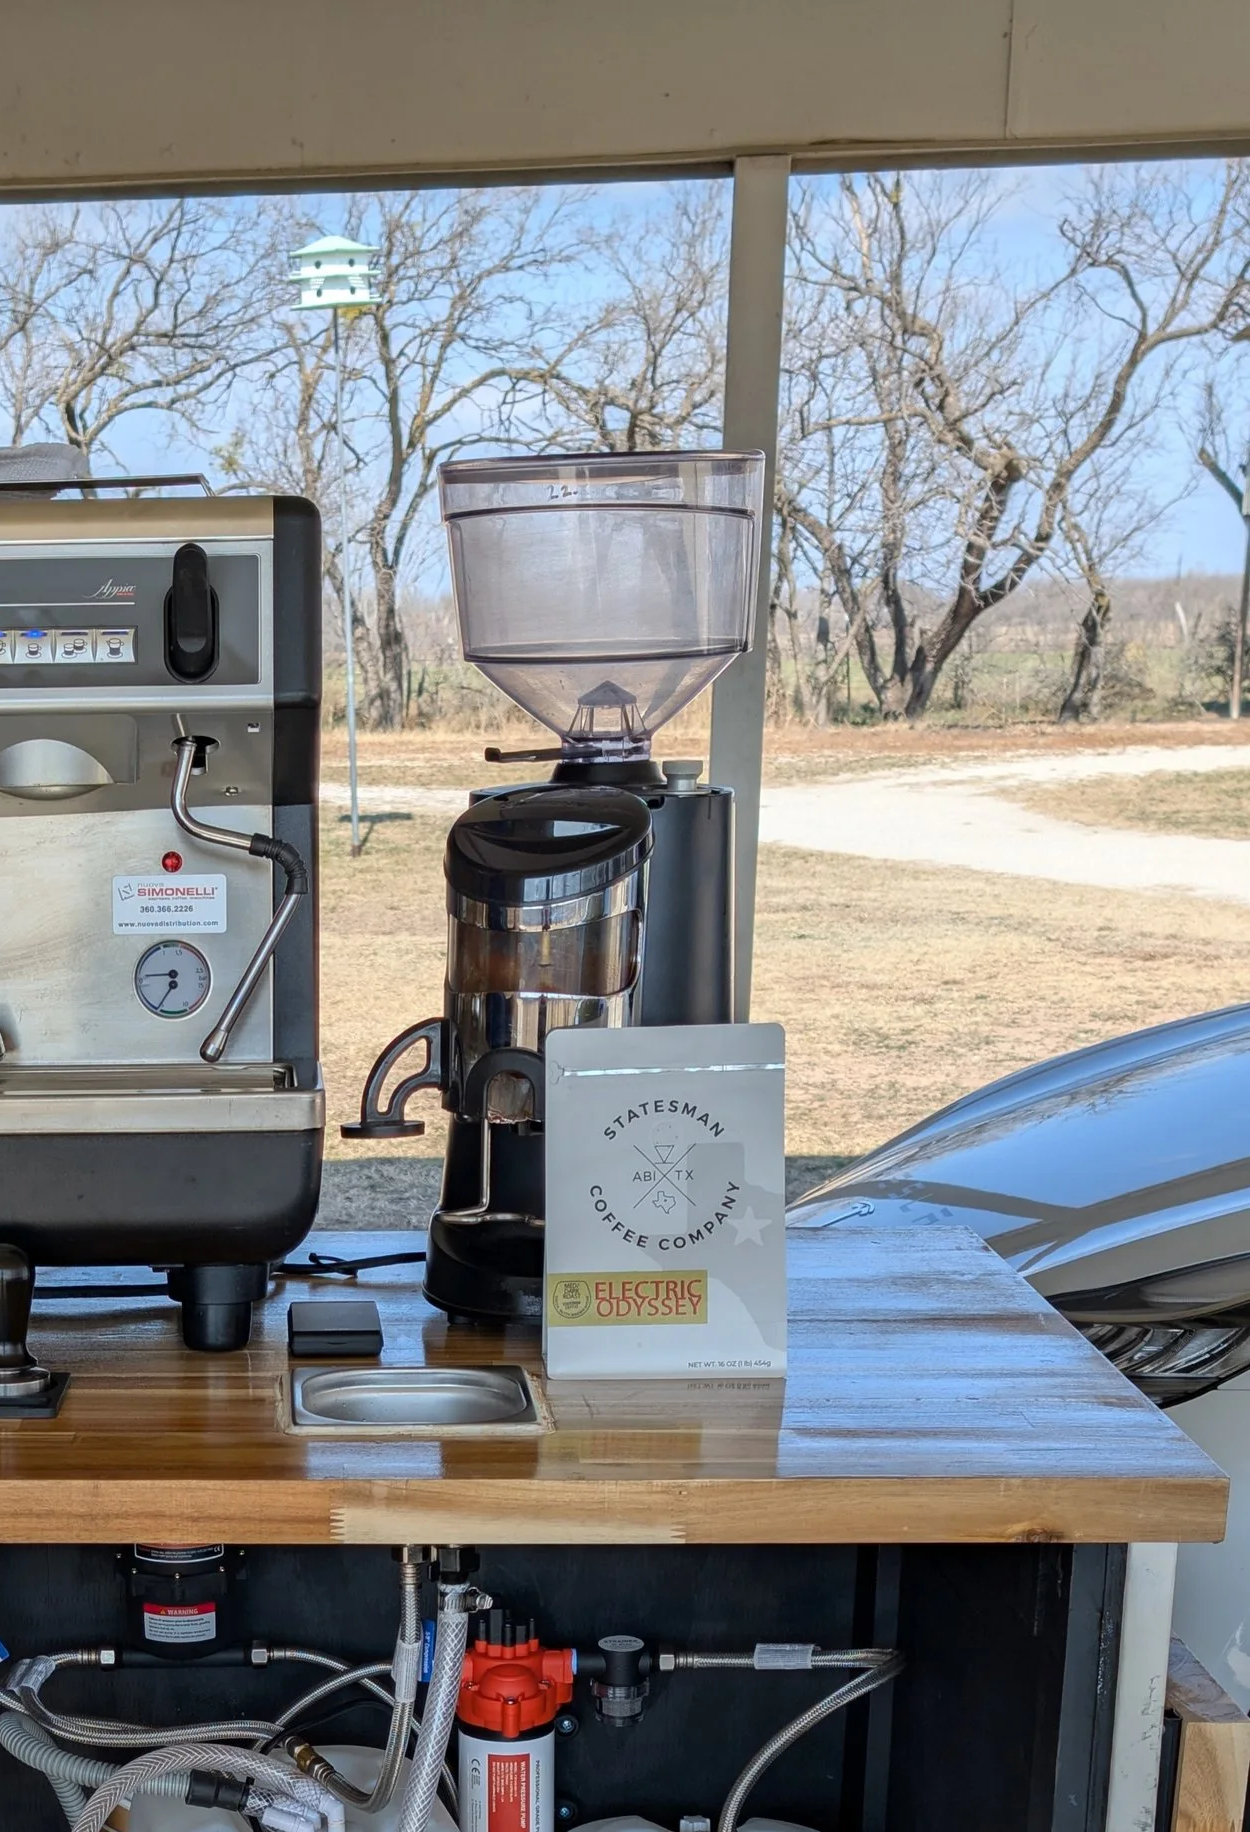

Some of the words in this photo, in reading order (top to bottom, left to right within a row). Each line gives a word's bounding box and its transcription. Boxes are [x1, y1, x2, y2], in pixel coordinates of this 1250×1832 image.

[138, 887, 215, 897] SIMONELLI
[140, 905, 194, 913] 360.366.2226
[603, 1099, 725, 1141] STATESMAN
[633, 1170, 656, 1182] ABI
[590, 1184, 648, 1249] COFFEE
[658, 1181, 741, 1251] COMPANY
[595, 1280, 702, 1300] ELECTRIC
[597, 1297, 702, 1317] ODYSSEY
